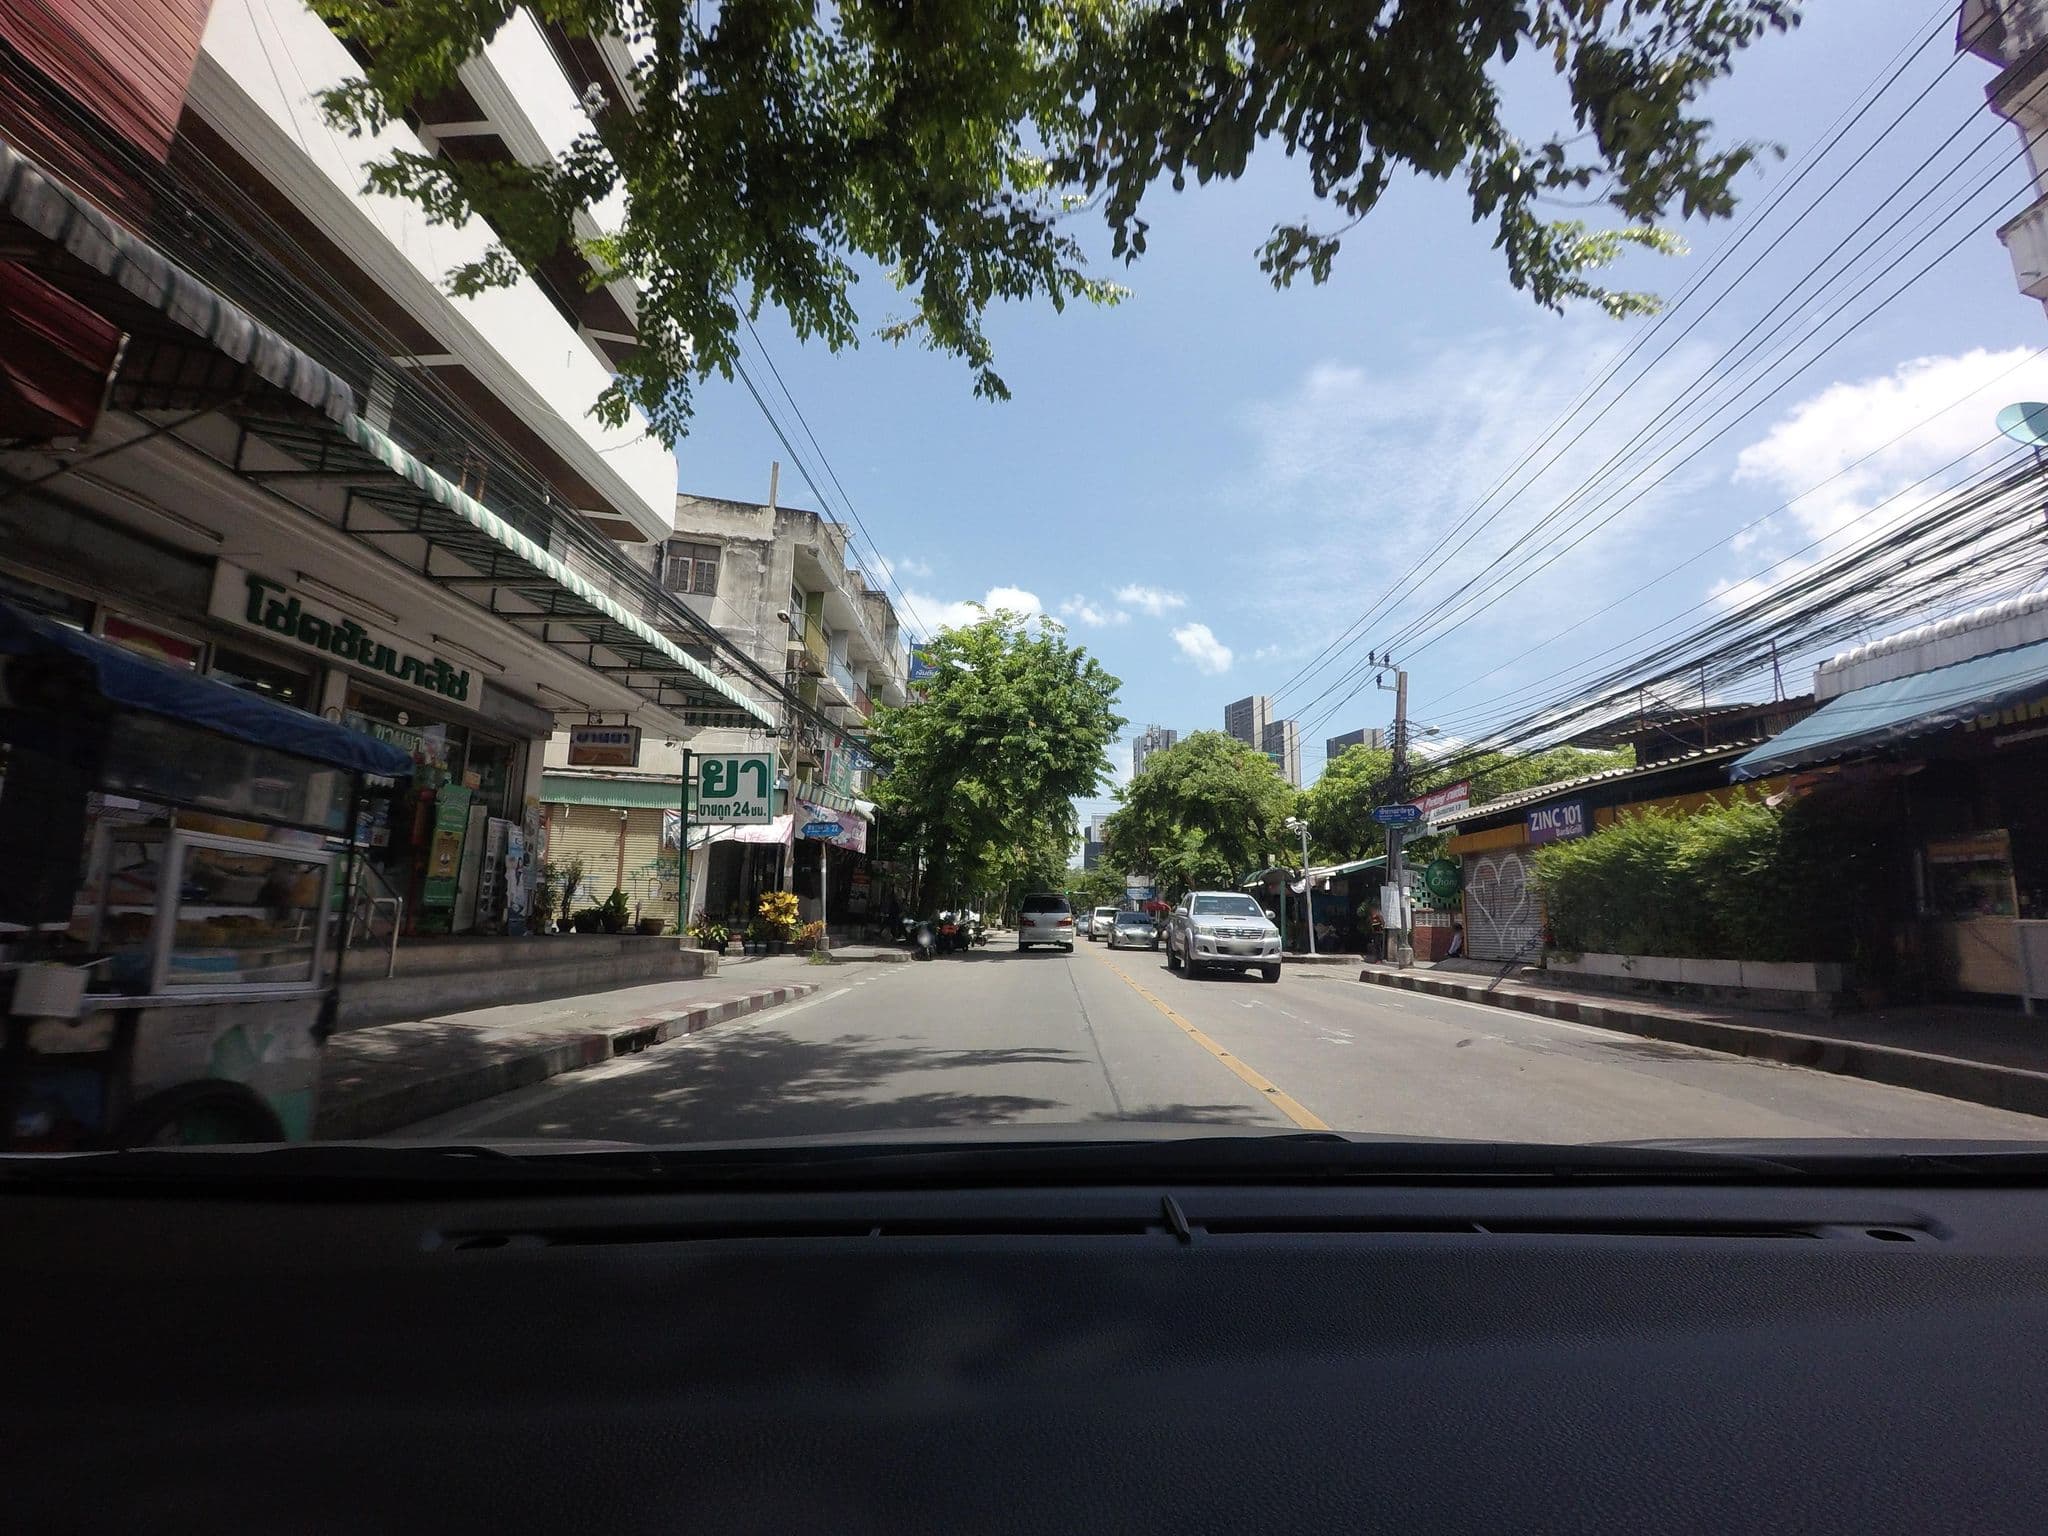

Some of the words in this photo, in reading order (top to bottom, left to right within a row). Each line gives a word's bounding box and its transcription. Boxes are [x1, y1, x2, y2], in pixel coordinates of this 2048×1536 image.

[246, 574, 470, 701] โชคชัยเภสัช
[702, 759, 767, 798] ยา
[733, 801, 750, 816] 24
[751, 806, 766, 816] ชม.
[1407, 808, 1415, 817] 13
[1530, 808, 1561, 832] ZINC
[1562, 804, 1582, 825] 101
